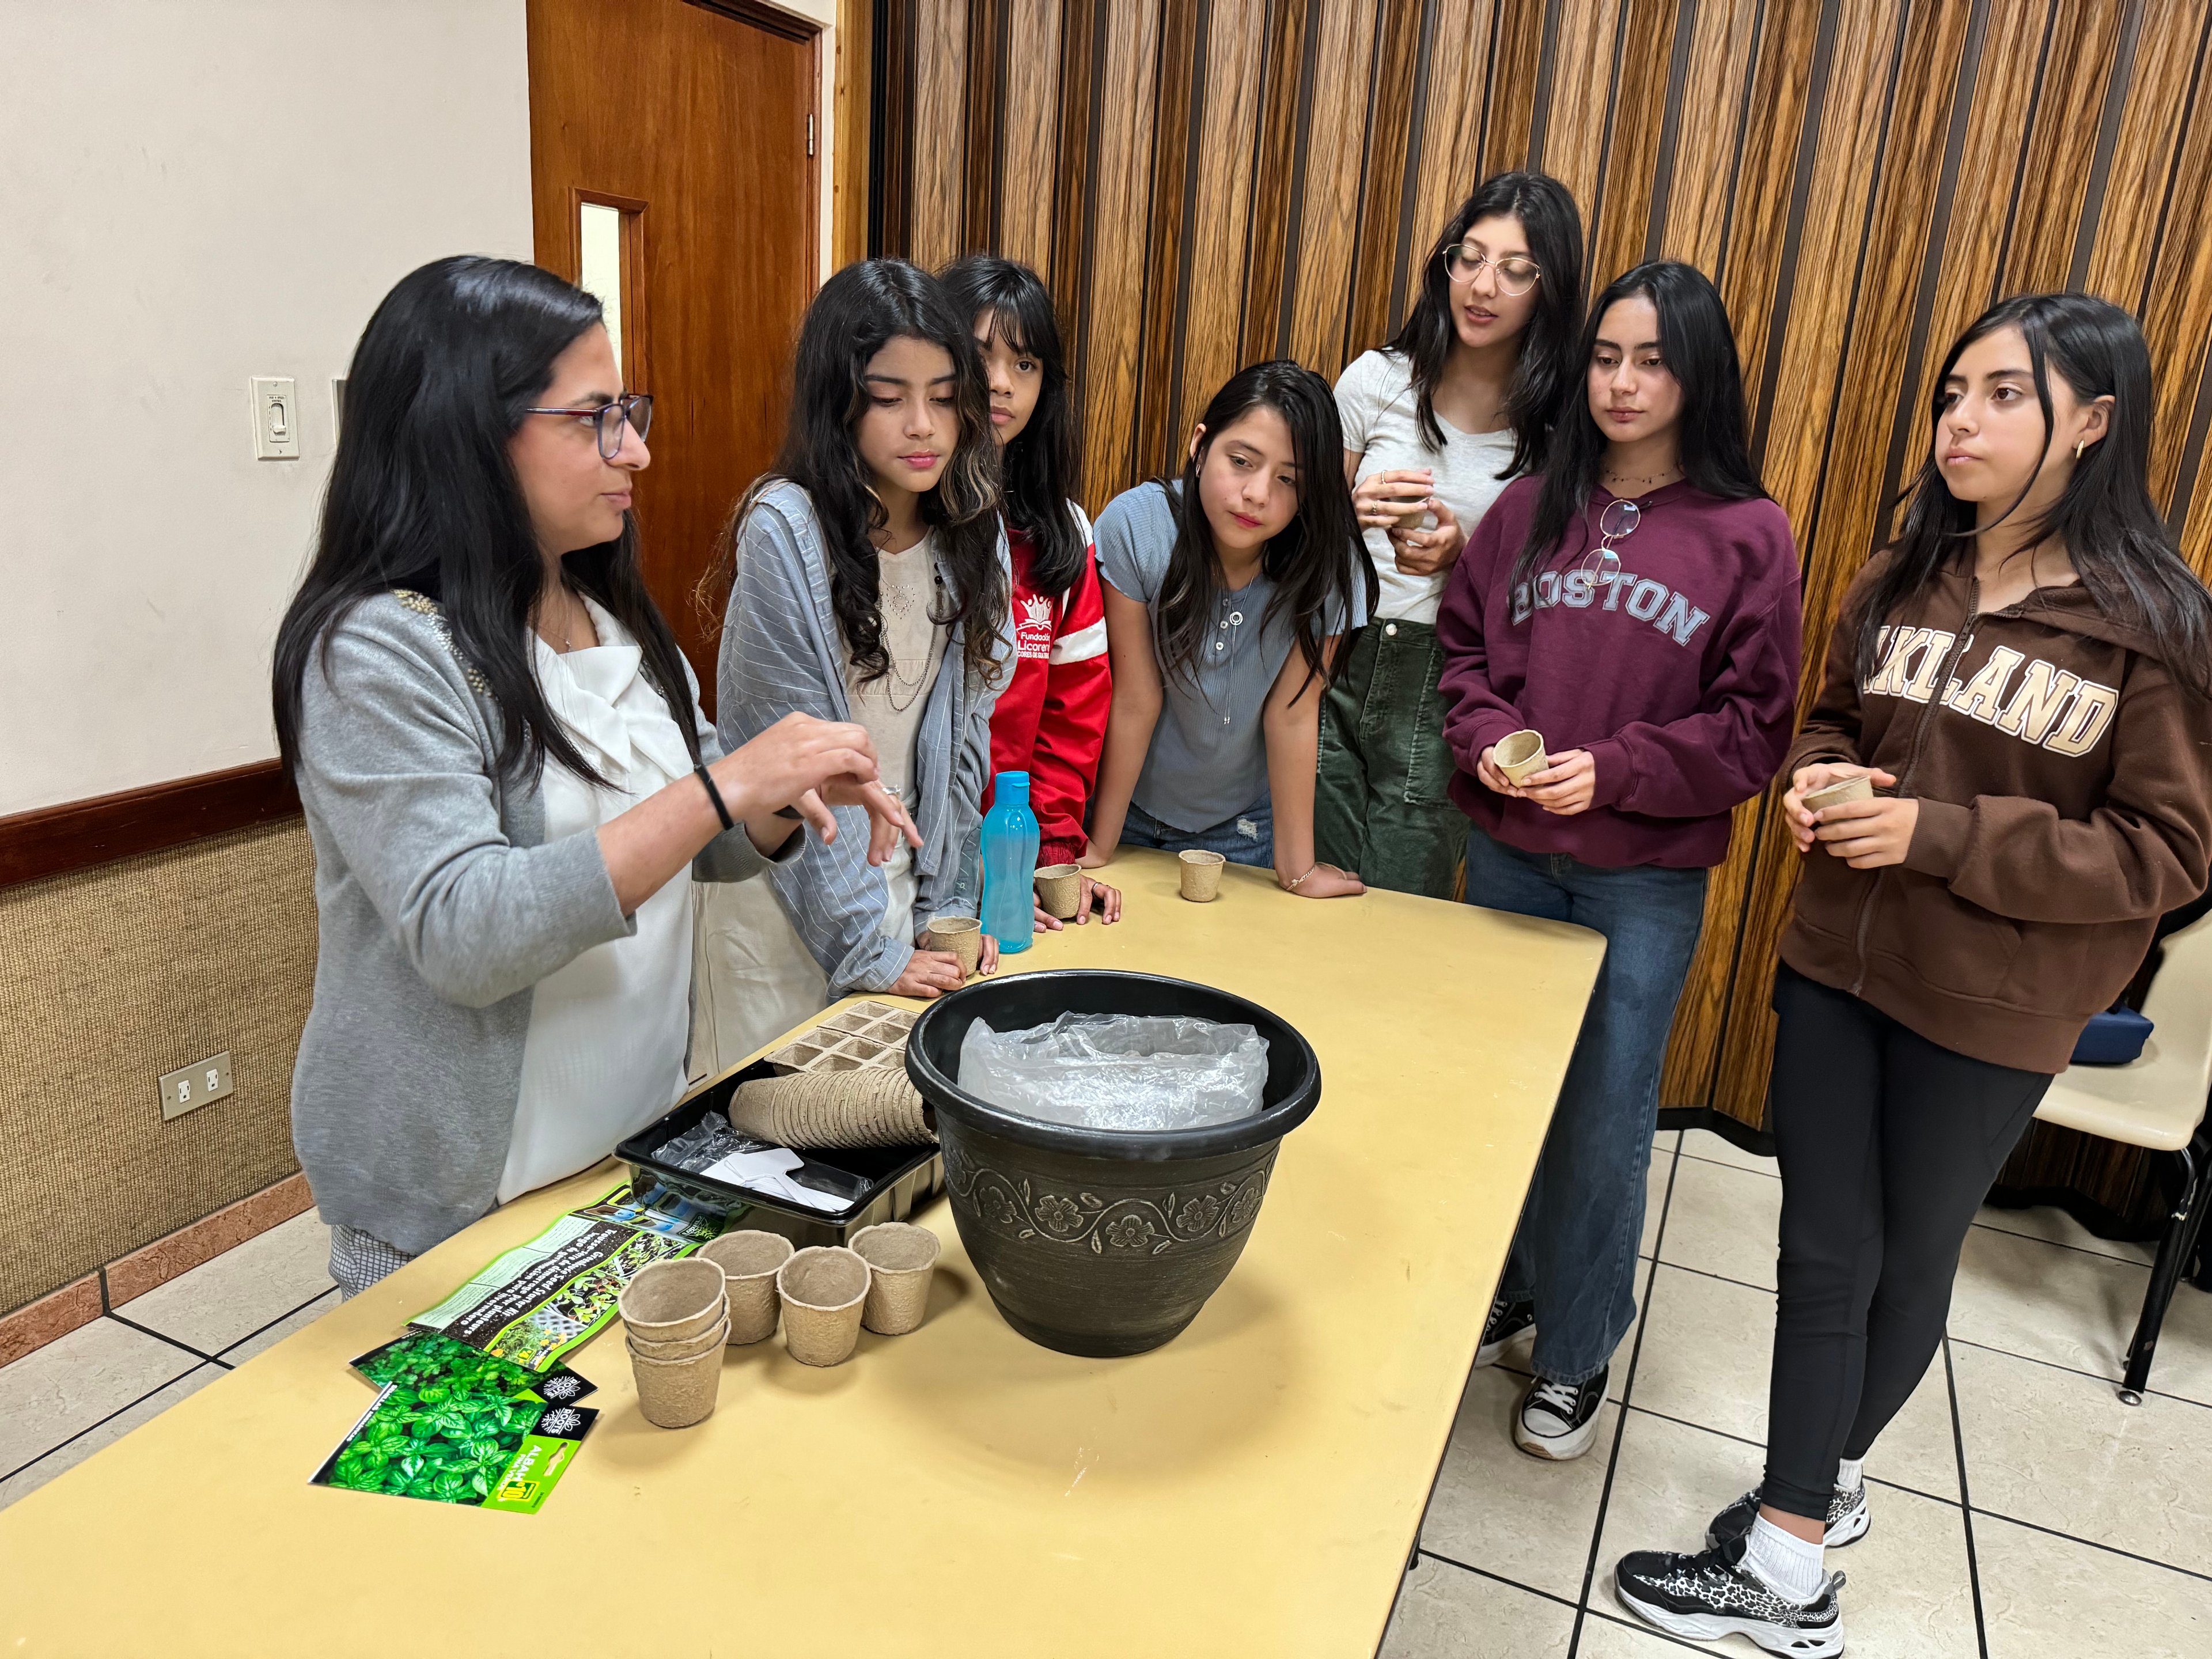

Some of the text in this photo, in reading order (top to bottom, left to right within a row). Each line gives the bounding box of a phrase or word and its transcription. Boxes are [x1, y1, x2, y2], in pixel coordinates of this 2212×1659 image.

[1506, 570, 1710, 647] BOSTON
[1863, 626, 2119, 757] KLAND
[560, 1251, 604, 1275] Greenhouse
[506, 1281, 527, 1294] para
[541, 1274, 565, 1290] Seed
[460, 1293, 510, 1325] invernadero
[502, 1294, 522, 1305] pour
[516, 1287, 546, 1308] Starter
[464, 1305, 502, 1335] planteurs
[547, 1378, 578, 1397] ROOTS
[551, 1408, 573, 1433] ROOTS
